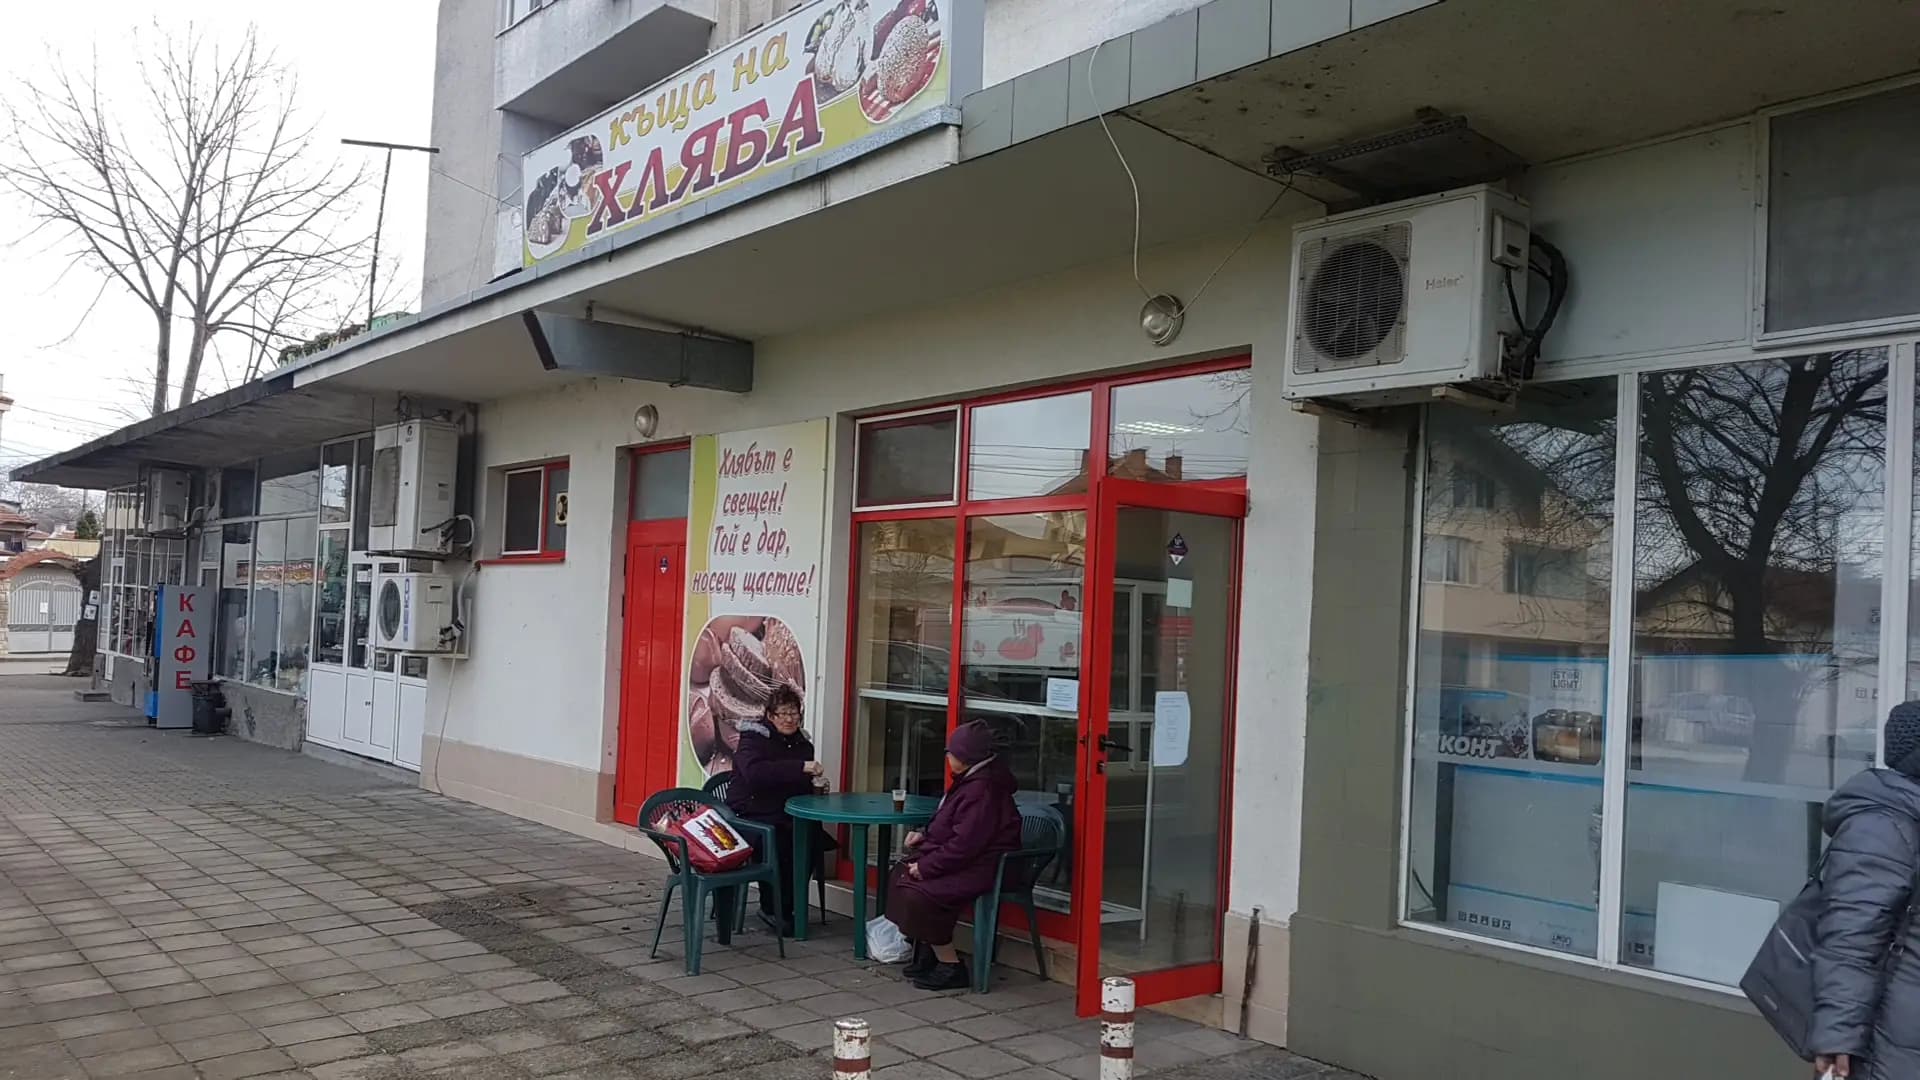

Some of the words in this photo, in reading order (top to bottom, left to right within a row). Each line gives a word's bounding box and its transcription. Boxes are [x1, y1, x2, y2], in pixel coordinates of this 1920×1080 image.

[608, 67, 718, 152] къща
[731, 31, 791, 92] на
[587, 77, 823, 236] ХЛЯБА
[719, 442, 776, 475] Хлябът
[783, 448, 793, 471] е
[723, 482, 787, 519] свещен!
[714, 524, 739, 553] Той
[742, 532, 751, 553] е
[757, 520, 790, 560] дар,
[692, 571, 736, 598] носещ
[743, 564, 815, 600] щастие!
[174, 593, 196, 690] КАФЕ
